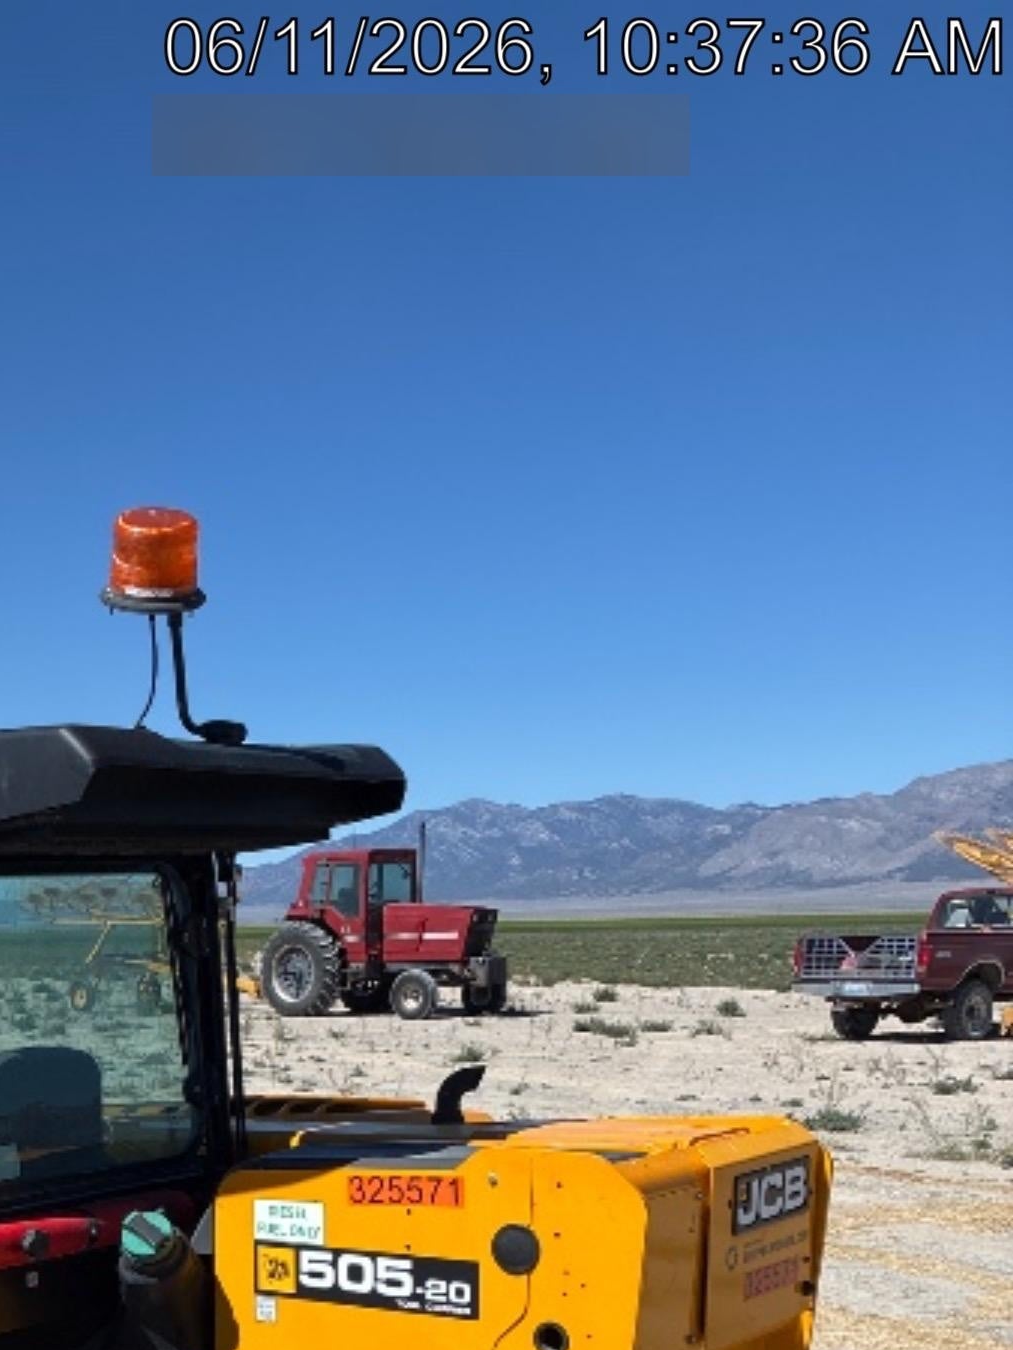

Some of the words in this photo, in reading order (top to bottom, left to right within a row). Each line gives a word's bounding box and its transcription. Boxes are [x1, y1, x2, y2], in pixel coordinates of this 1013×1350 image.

[349, 1175, 462, 1206] 325571
[738, 1165, 807, 1226] JCB
[298, 1250, 471, 1304] 505-20
